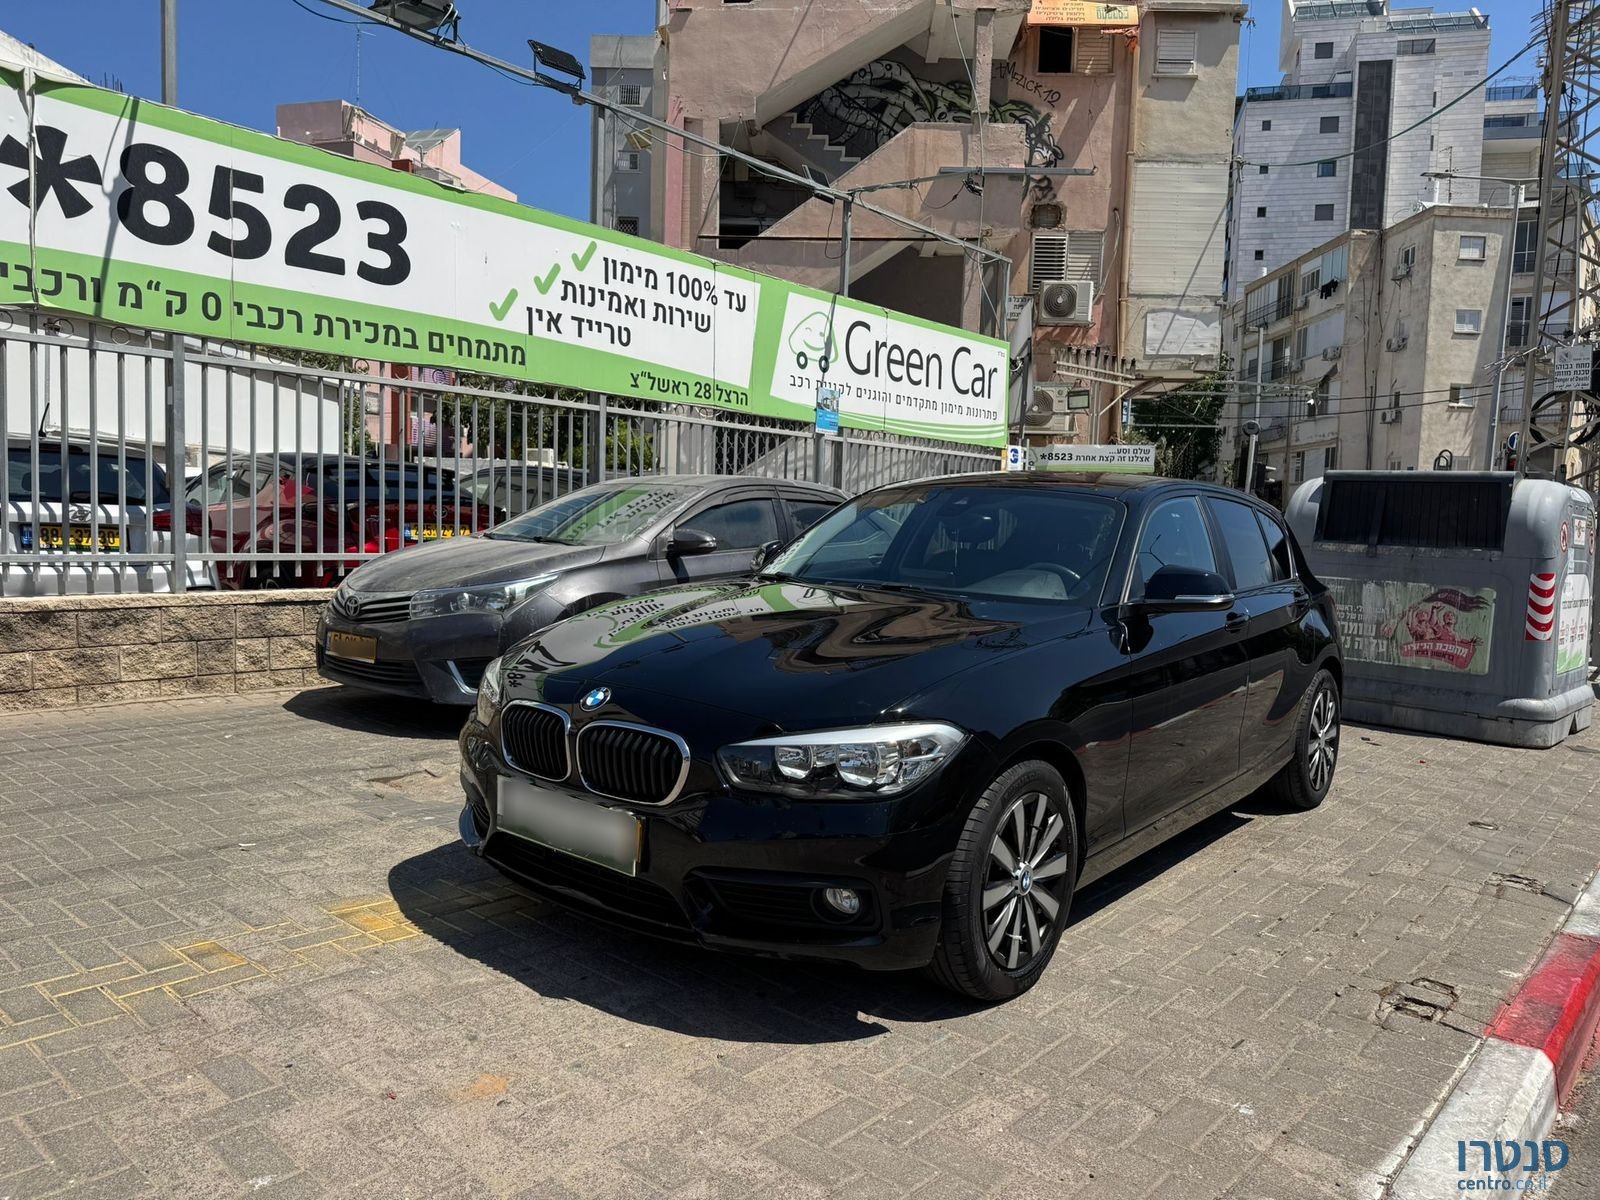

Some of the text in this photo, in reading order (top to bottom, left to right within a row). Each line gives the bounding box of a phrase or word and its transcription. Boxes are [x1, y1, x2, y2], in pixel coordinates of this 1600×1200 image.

[603, 256, 746, 312] עד 100% מימון
[0, 262, 526, 366] מתמחים במכירת רכבי 0 ק"מ ורכבי
[561, 279, 711, 333] שירות ואמינות
[526, 306, 631, 347] טרייד אין
[845, 320, 998, 400] Green Car
[789, 374, 811, 389] רכב
[694, 383, 712, 400] 28
[716, 384, 748, 406] הרצל
[856, 386, 892, 404] והוגנים
[896, 395, 938, 414] מתקדמים
[941, 401, 963, 415] מימון
[966, 406, 998, 421] פתרונות
[1098, 455, 1115, 463] קצת
[1133, 447, 1150, 455] שלם
